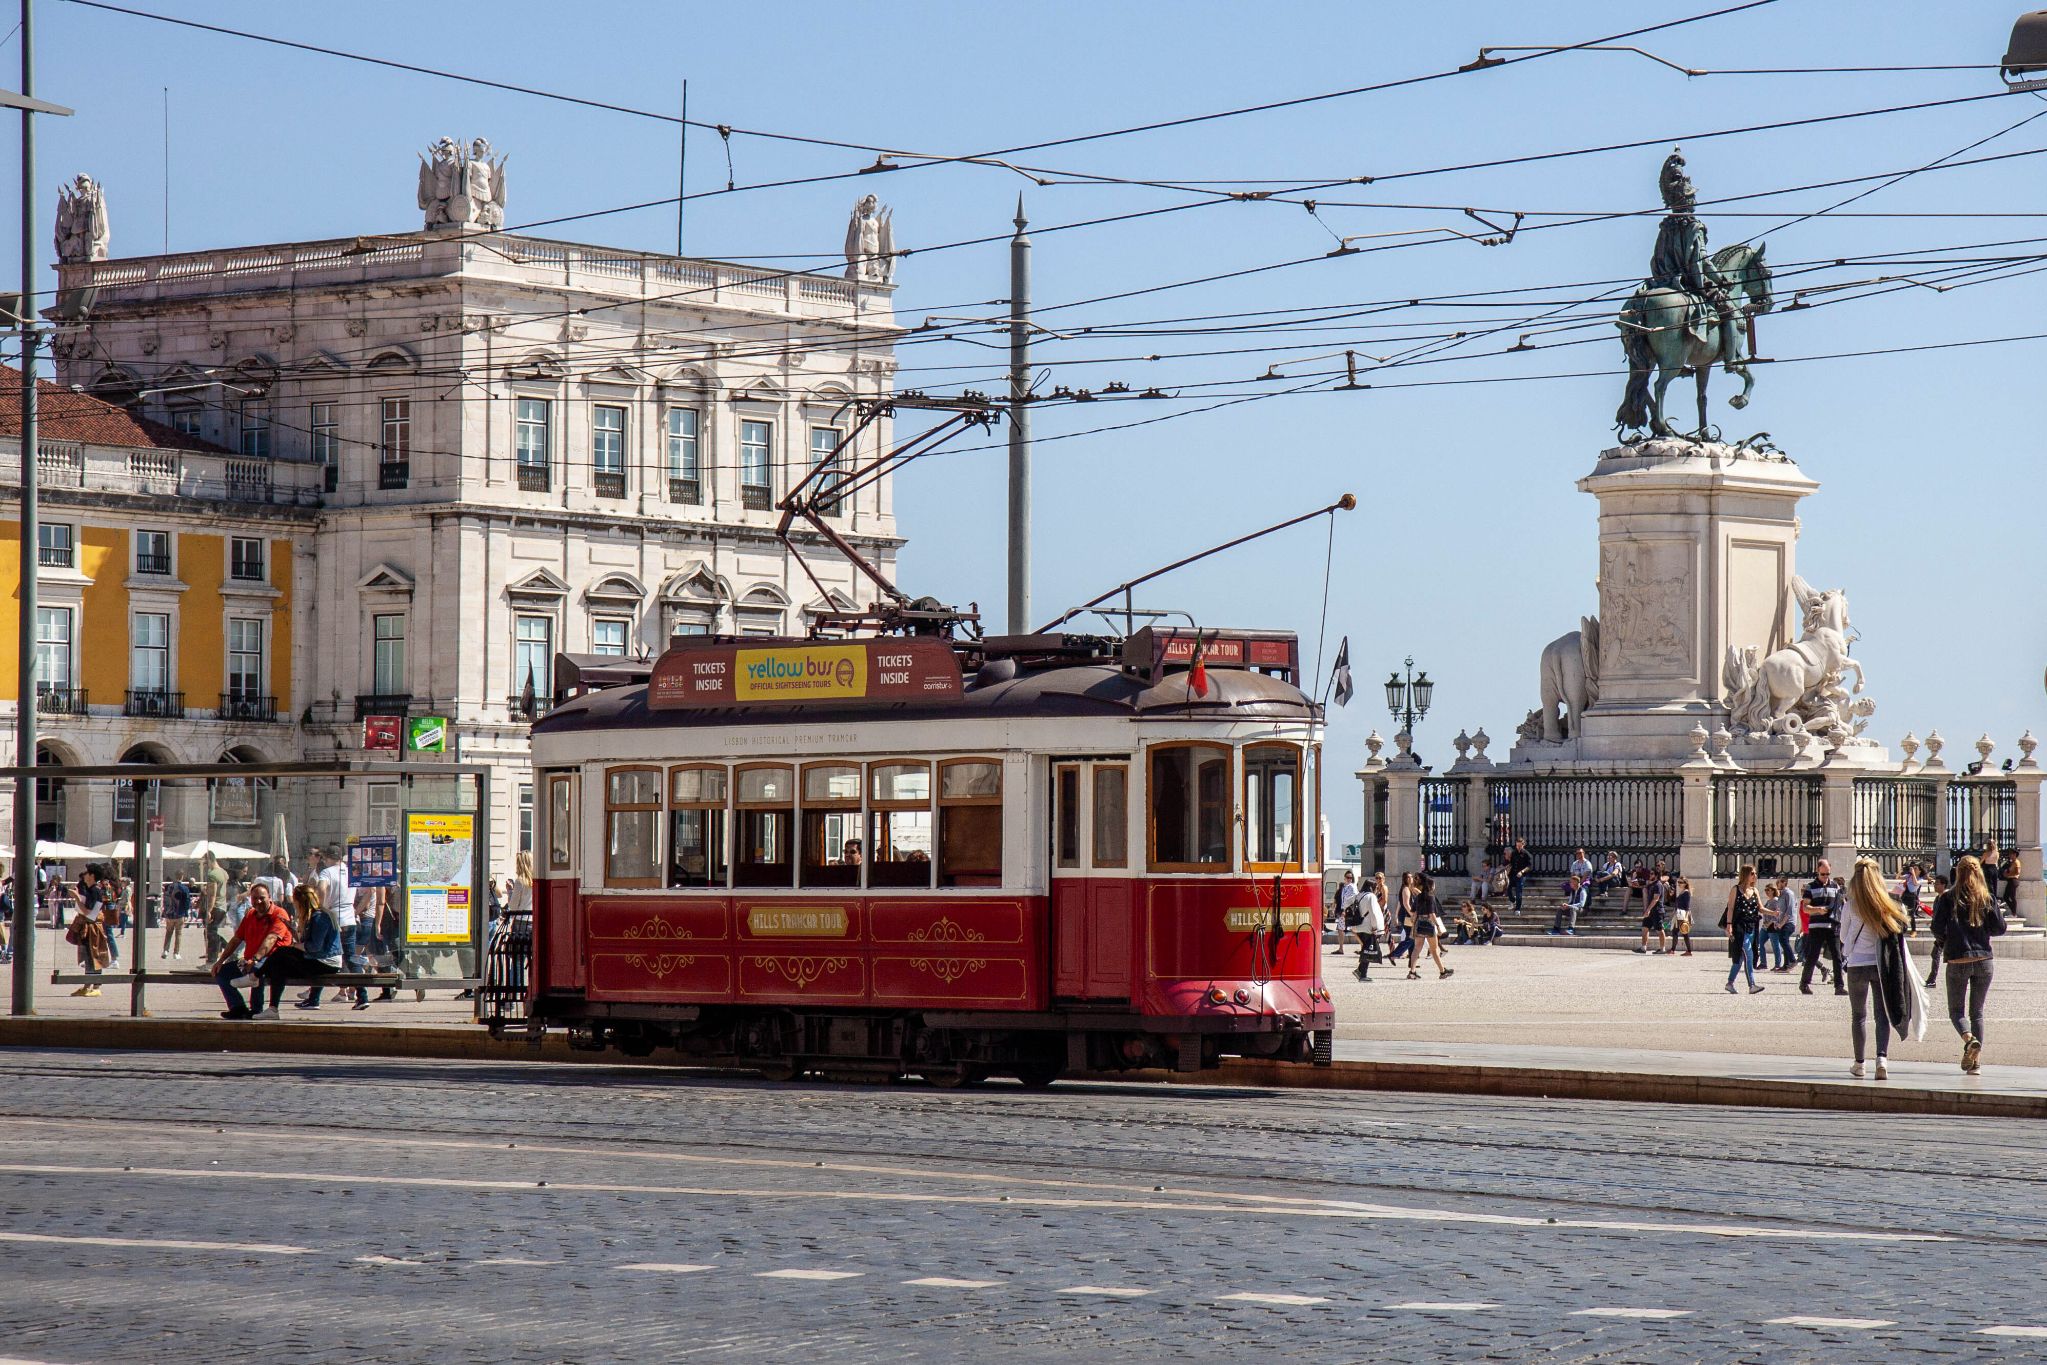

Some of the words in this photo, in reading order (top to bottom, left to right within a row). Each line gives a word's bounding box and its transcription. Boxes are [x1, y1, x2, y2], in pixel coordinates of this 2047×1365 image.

[1167, 642, 1188, 655] HILLS
[1221, 644, 1239, 656] TOUR
[747, 657, 804, 679] yellow
[806, 656, 834, 676] bus
[877, 654, 913, 668] TICKETS
[692, 662, 726, 675] TICKETS
[695, 678, 723, 691] INSIDE
[750, 682, 774, 690] OFFICIAL
[775, 681, 811, 689] SIGHTSEEING
[812, 680, 831, 688] TOURS
[880, 672, 910, 685] INSIDE
[724, 736, 748, 746] LISBON
[752, 735, 790, 745] HISTORICAL
[794, 735, 824, 744] PREMIUM
[828, 734, 857, 743] TRAMCAR
[753, 913, 779, 929] HILLS
[820, 913, 843, 929] TOUR
[1230, 912, 1260, 926] HILLS
